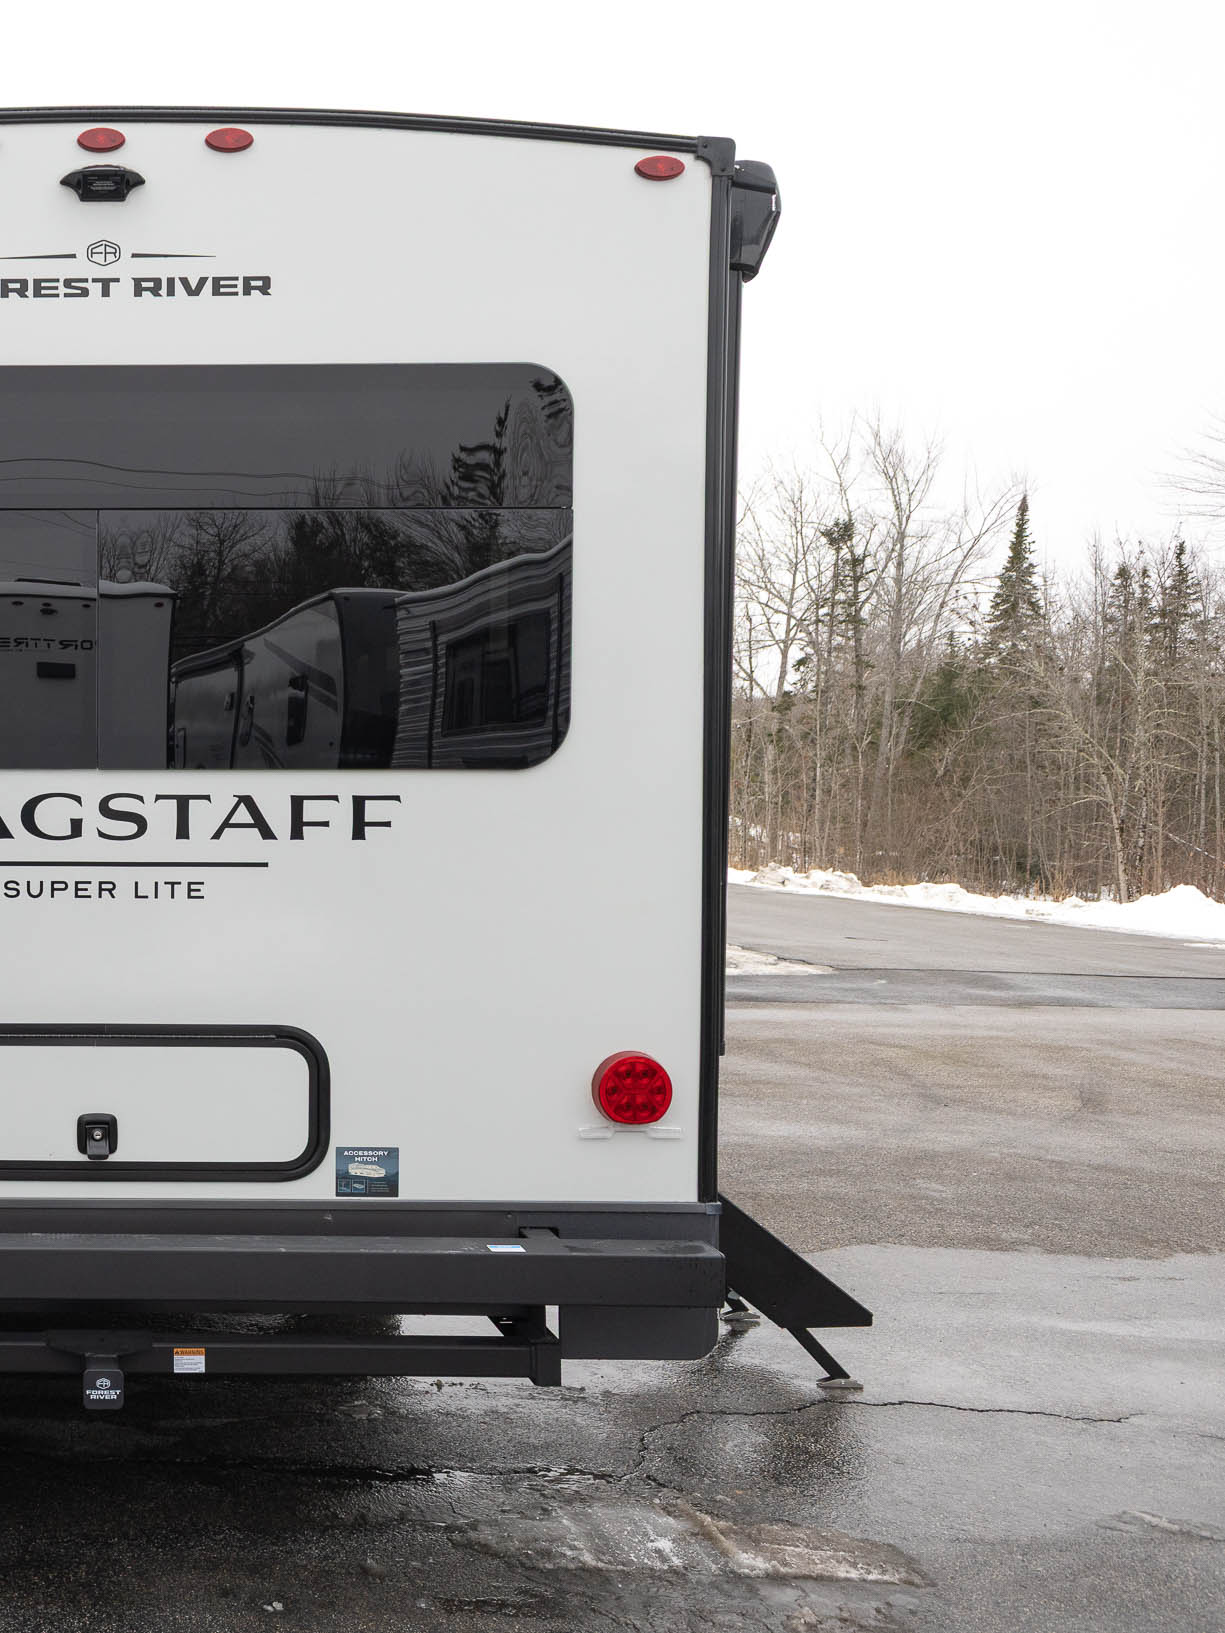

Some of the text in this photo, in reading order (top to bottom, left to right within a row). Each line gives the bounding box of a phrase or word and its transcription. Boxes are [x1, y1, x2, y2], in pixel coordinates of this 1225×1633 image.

[131, 275, 272, 298] RIVER
[3, 880, 205, 900] SUPER LITE
